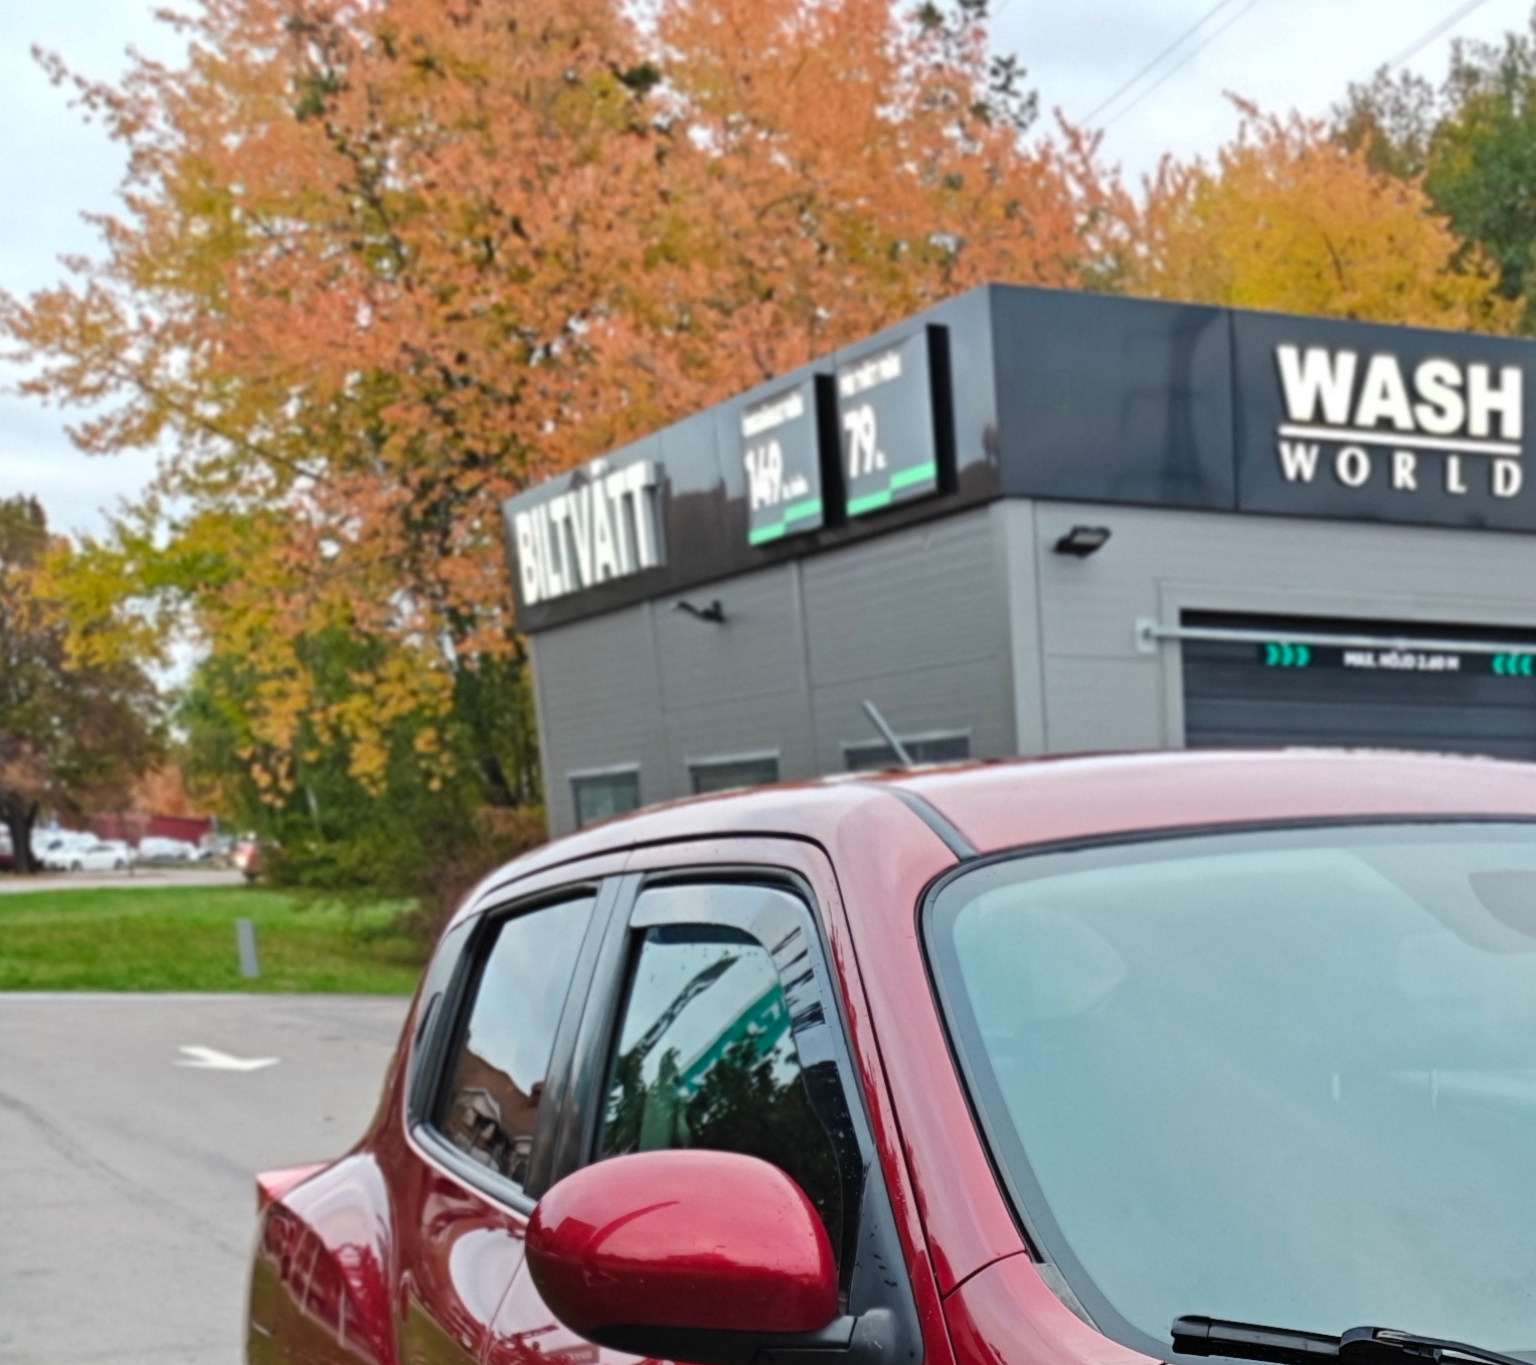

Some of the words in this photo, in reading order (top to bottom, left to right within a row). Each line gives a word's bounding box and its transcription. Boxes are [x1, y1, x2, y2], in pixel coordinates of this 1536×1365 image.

[1277, 345, 1522, 439] WASH
[1279, 442, 1522, 497] WORLD
[515, 458, 657, 606] BILTVÄTT
